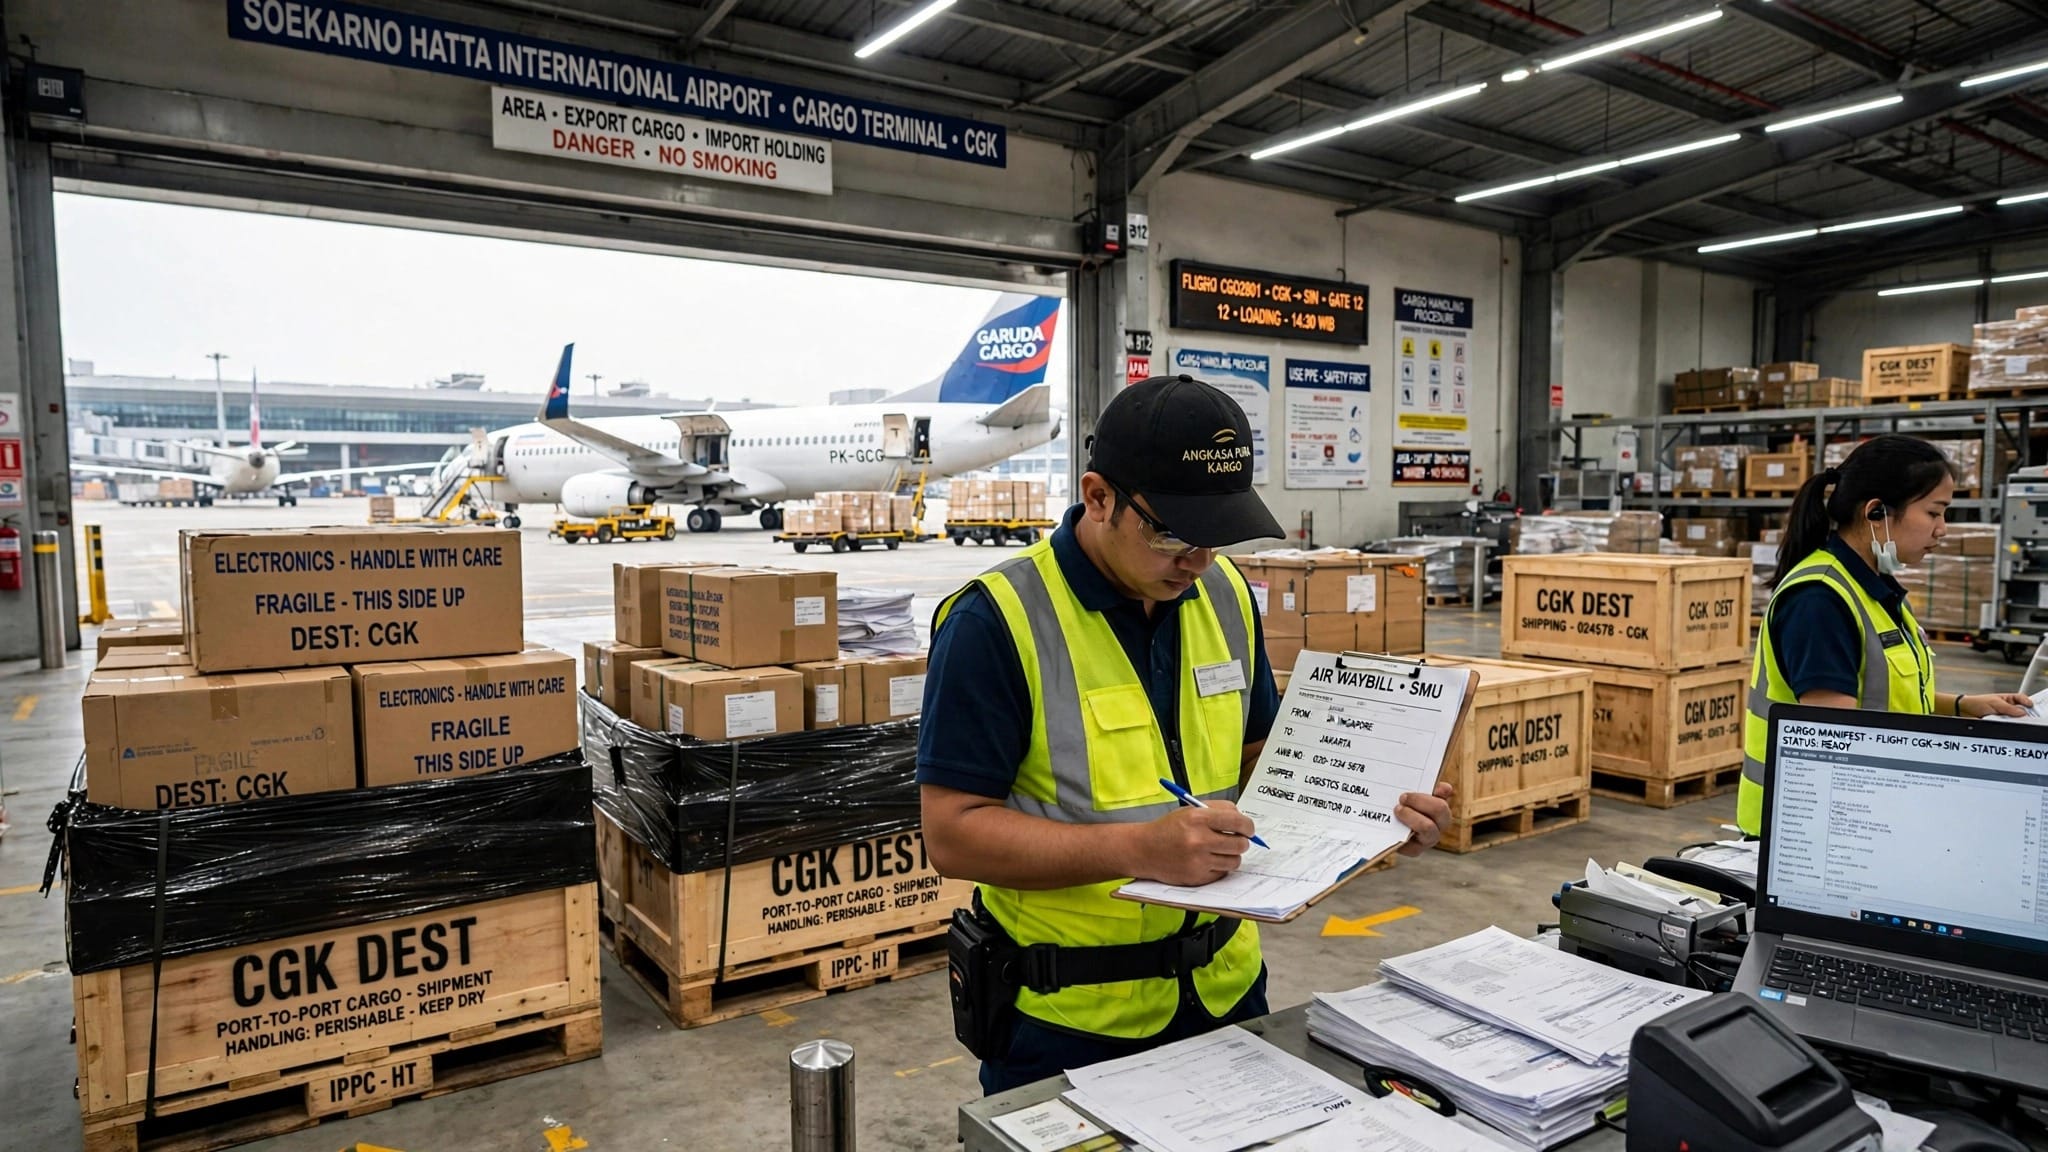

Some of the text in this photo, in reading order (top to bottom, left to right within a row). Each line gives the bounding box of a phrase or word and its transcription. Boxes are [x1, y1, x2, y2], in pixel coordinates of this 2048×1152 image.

[243, 0, 998, 158] SOEKARNO HATTA INTERNATIONAL AIRPORT CARGO TERMINAL CGK
[502, 96, 825, 164] AREA EXPORT CARGO IMPORT HOLDING
[553, 129, 777, 180] DANGER NO SMOKING
[1328, 291, 1350, 309] GATE
[1353, 295, 1364, 311] 12
[1217, 304, 1230, 320] 12
[1240, 306, 1281, 327] LOADING
[1318, 315, 1335, 332] WIB
[977, 326, 1044, 345] GARUDA
[979, 342, 1037, 360] CARGO
[1906, 357, 1935, 370] DEST
[1289, 367, 1367, 385] USE PPE SAFETY FIRST
[1182, 448, 1233, 461] ANGKASA
[1208, 461, 1242, 473] KARGO
[215, 547, 502, 573] ELECTRONICS HANDLE WITH CARE
[255, 587, 464, 614] FRAGILE THIS SIDE UP
[1537, 588, 1634, 618] CGK DEST
[1689, 601, 1708, 620] CGK
[291, 621, 419, 650] DEST: CGK
[1522, 617, 1648, 640] SHIPPING 024578 CGK
[380, 677, 565, 708] ELECTRONICS HANDLE WITH CARE
[1309, 667, 1443, 699] AIR WAYBILL SMU
[1685, 695, 1735, 725] CGK DEST
[431, 716, 511, 741] FRAGILE
[1319, 734, 1351, 749] JAKARTA
[1488, 714, 1562, 751] CGK DEST
[1783, 725, 1816, 736] CARGO
[1818, 728, 1866, 742] MANIFEST
[1876, 734, 1909, 745] FLIGHT
[2014, 748, 2048, 760] READY
[414, 745, 524, 774] THIS SIDE UP
[1347, 763, 1365, 774] 5678
[1477, 754, 1514, 773] SHIPPING
[1554, 744, 1569, 758] CGK
[156, 771, 289, 809] DEST: CGK
[1358, 808, 1391, 823] JAKARTA
[772, 832, 927, 896] CGK DEST
[762, 875, 943, 920] PORT-TO-PORT CARGO SHIPMENT
[768, 890, 939, 935] HANDLING: PERISHABLE KEEP DRY
[233, 916, 477, 1007] CGK DEST
[832, 950, 889, 978] IPPC HT
[217, 970, 493, 1037] PORT-TO-PORT CARGO SHIPMENT
[226, 990, 486, 1056] HANDLING: PERISHABLE KEEP DRY
[330, 1063, 416, 1102] IPPC HT
